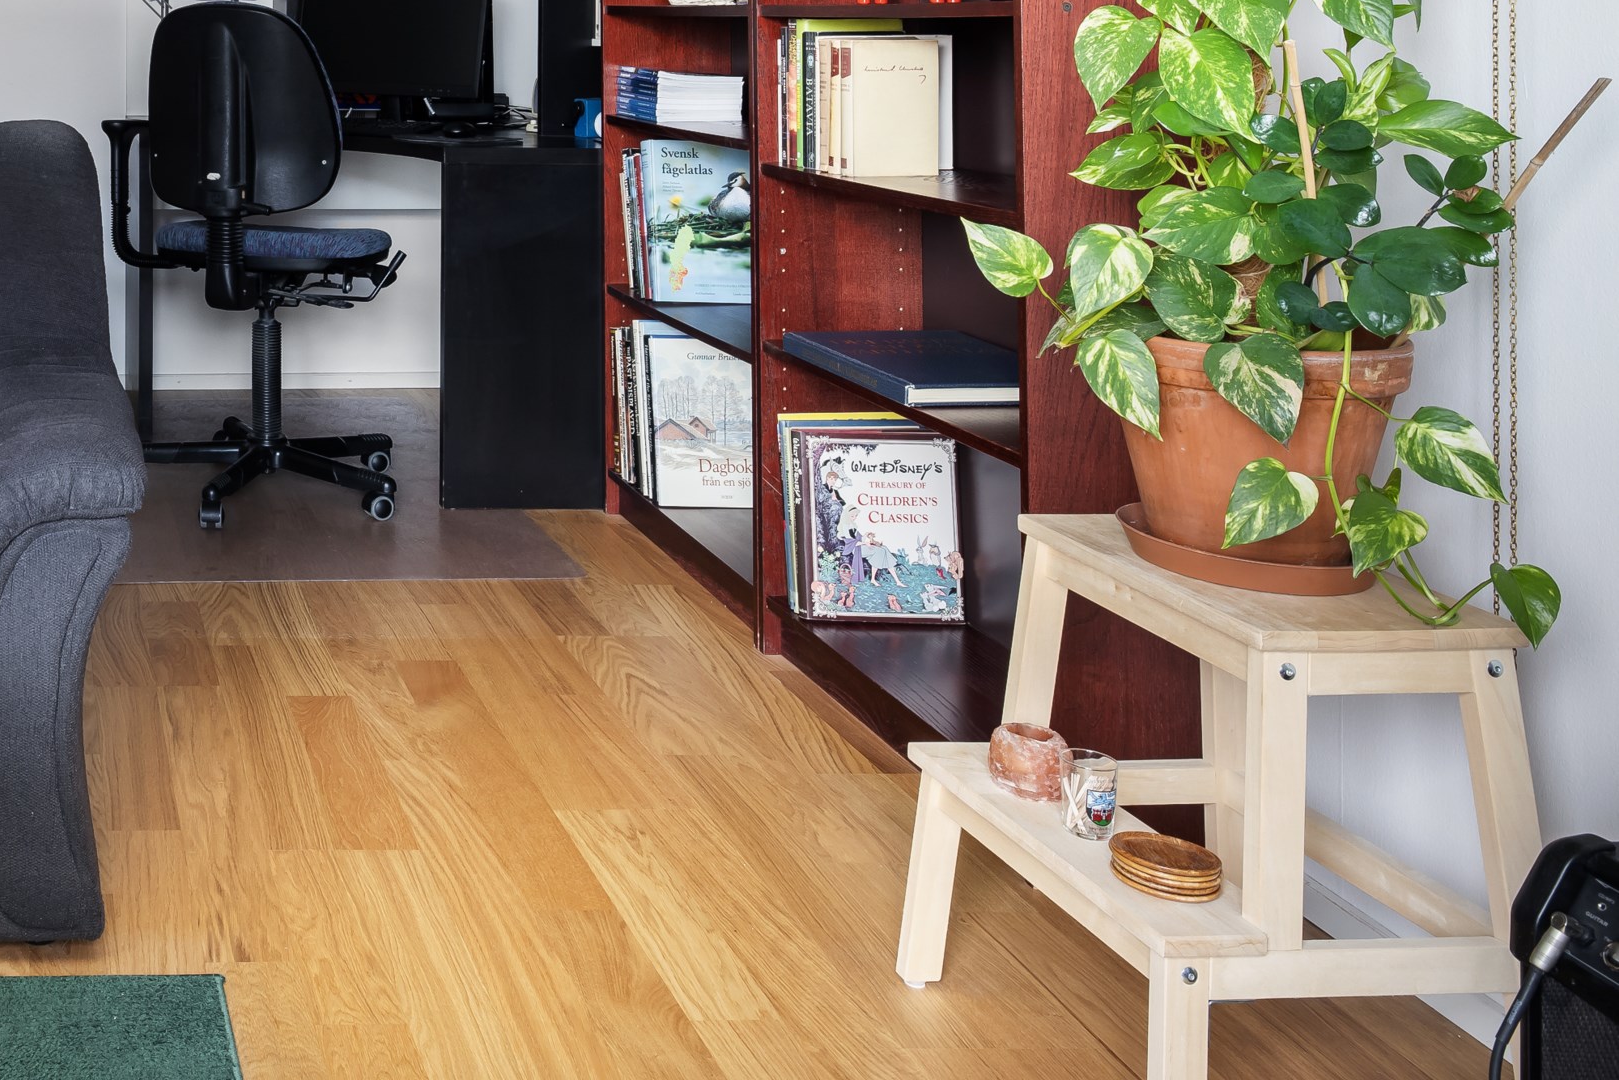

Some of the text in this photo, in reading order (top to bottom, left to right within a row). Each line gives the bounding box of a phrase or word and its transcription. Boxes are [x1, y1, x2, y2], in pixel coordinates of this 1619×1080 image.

[806, 78, 814, 136] BATAVIA
[661, 146, 700, 159] Svensk
[662, 163, 712, 177] fågelatlas
[686, 352, 716, 360] Gunnar
[698, 458, 752, 476] Dagbok
[850, 461, 877, 473] WALT
[702, 476, 720, 486] från
[738, 477, 750, 489] sjö
[869, 481, 913, 489] TREASURY
[858, 493, 938, 506] CHILDREN'S
[868, 511, 928, 524] CLASSICS
[1586, 911, 1608, 926] GUITAR
